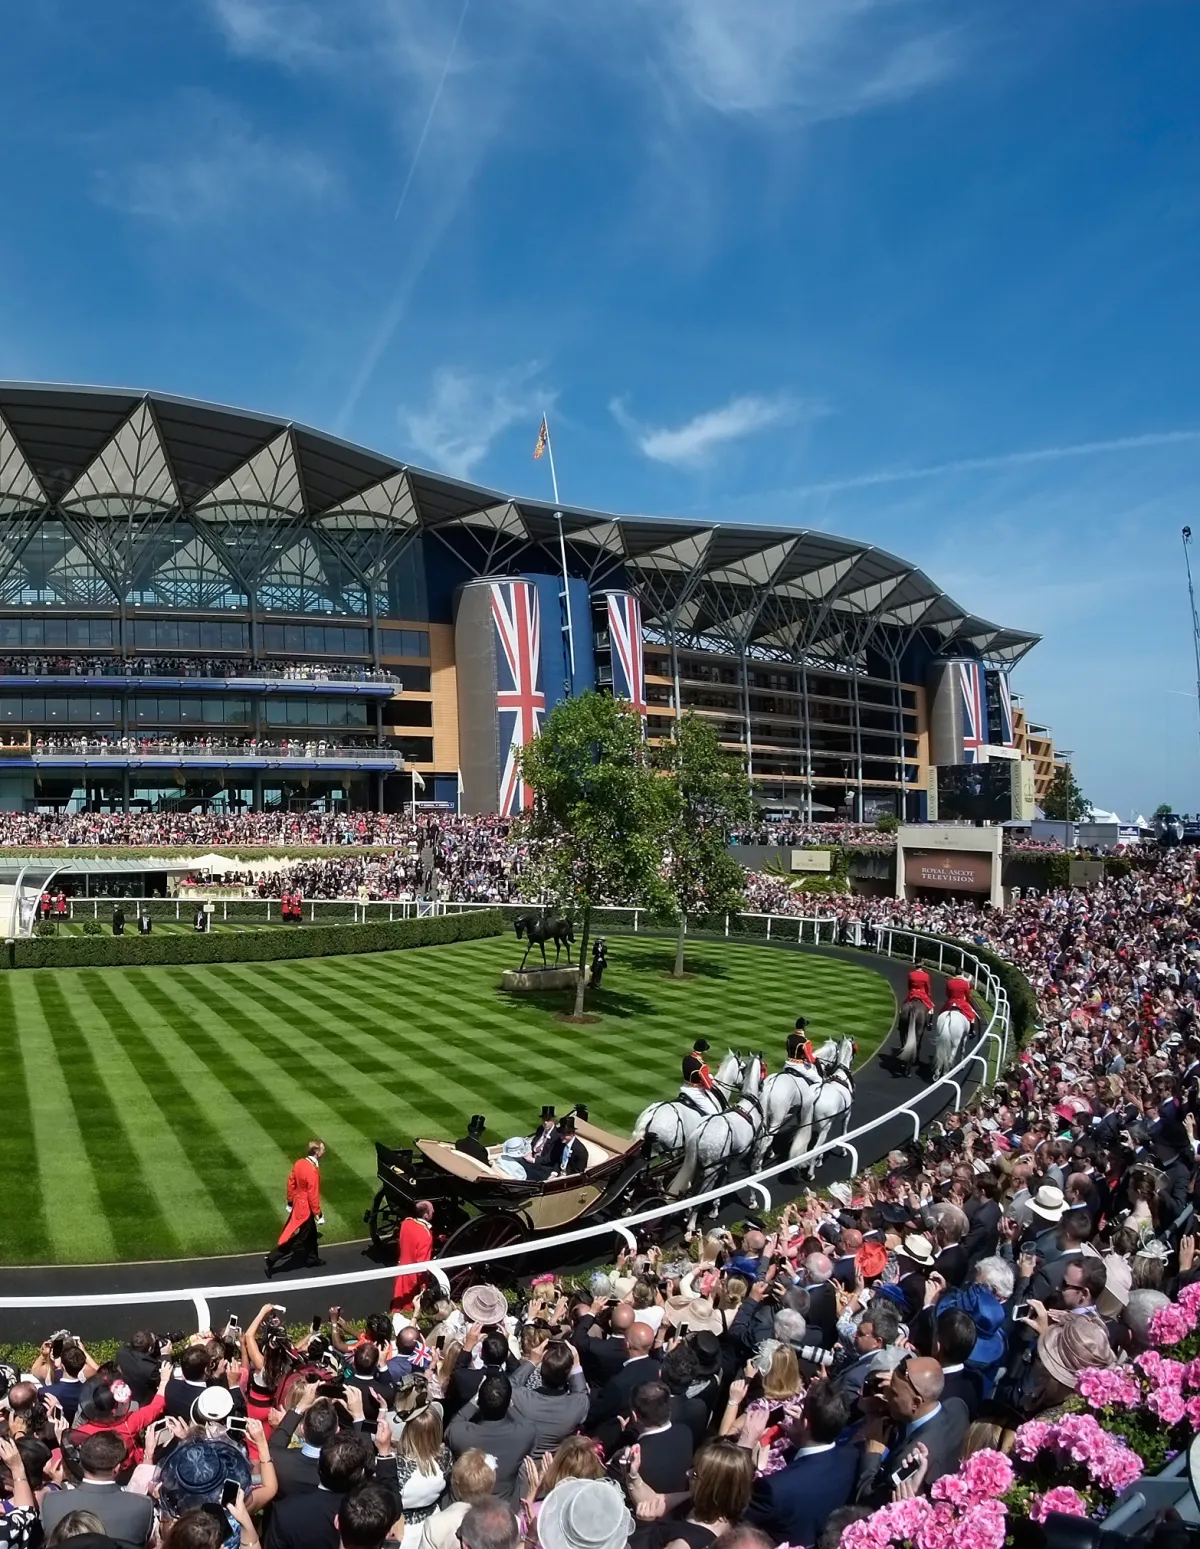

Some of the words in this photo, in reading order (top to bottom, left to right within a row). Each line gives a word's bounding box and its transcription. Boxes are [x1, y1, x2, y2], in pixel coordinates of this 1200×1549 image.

[921, 867, 947, 875] ROYAL
[949, 869, 975, 877] ASCOT
[921, 873, 974, 883] TELEVISION
